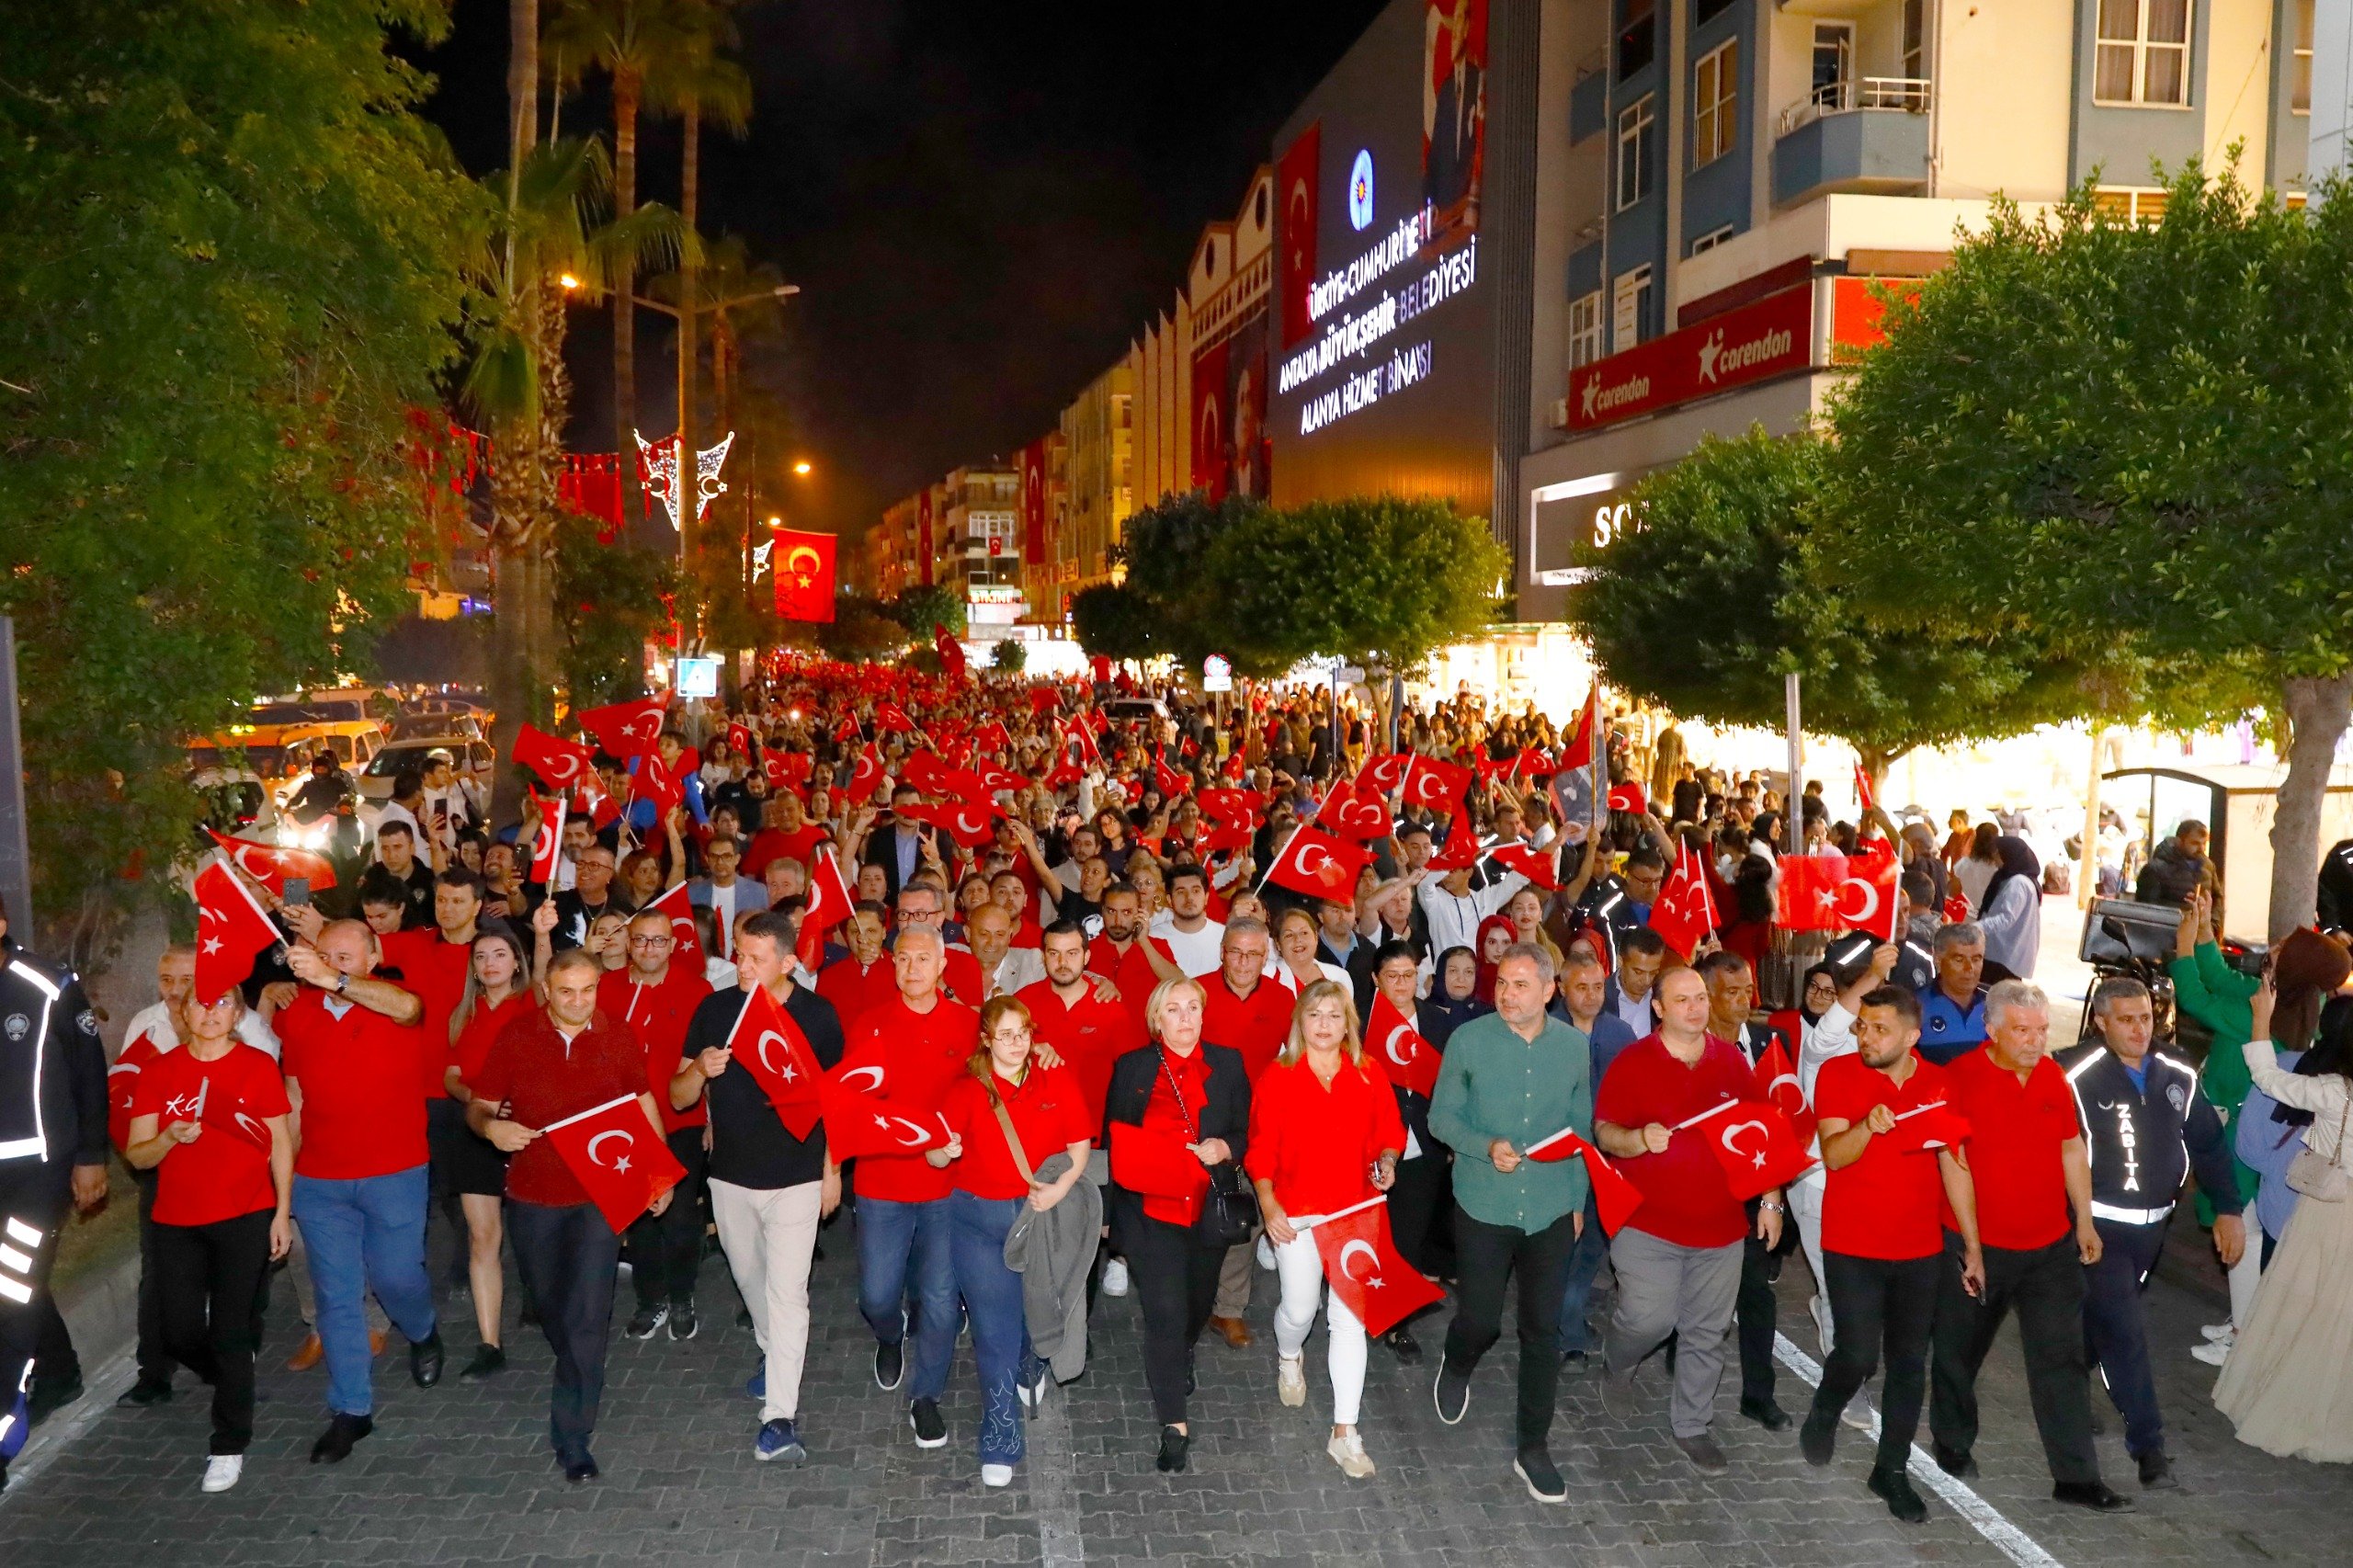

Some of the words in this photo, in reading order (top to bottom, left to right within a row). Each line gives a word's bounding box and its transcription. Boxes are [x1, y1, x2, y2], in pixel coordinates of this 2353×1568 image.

[1279, 345, 1319, 394] ANTALYA
[1320, 290, 1396, 371] BÜYÜKŞEHİR
[1400, 234, 1476, 324] BELEDİYESİ
[1720, 327, 1791, 374] corendon
[1302, 388, 1341, 435] ALANYA
[1343, 366, 1384, 416] HİZMET
[1387, 340, 1432, 394] BİNASI
[1597, 374, 1650, 412] corendon
[2117, 1104, 2141, 1191] ZABITA
